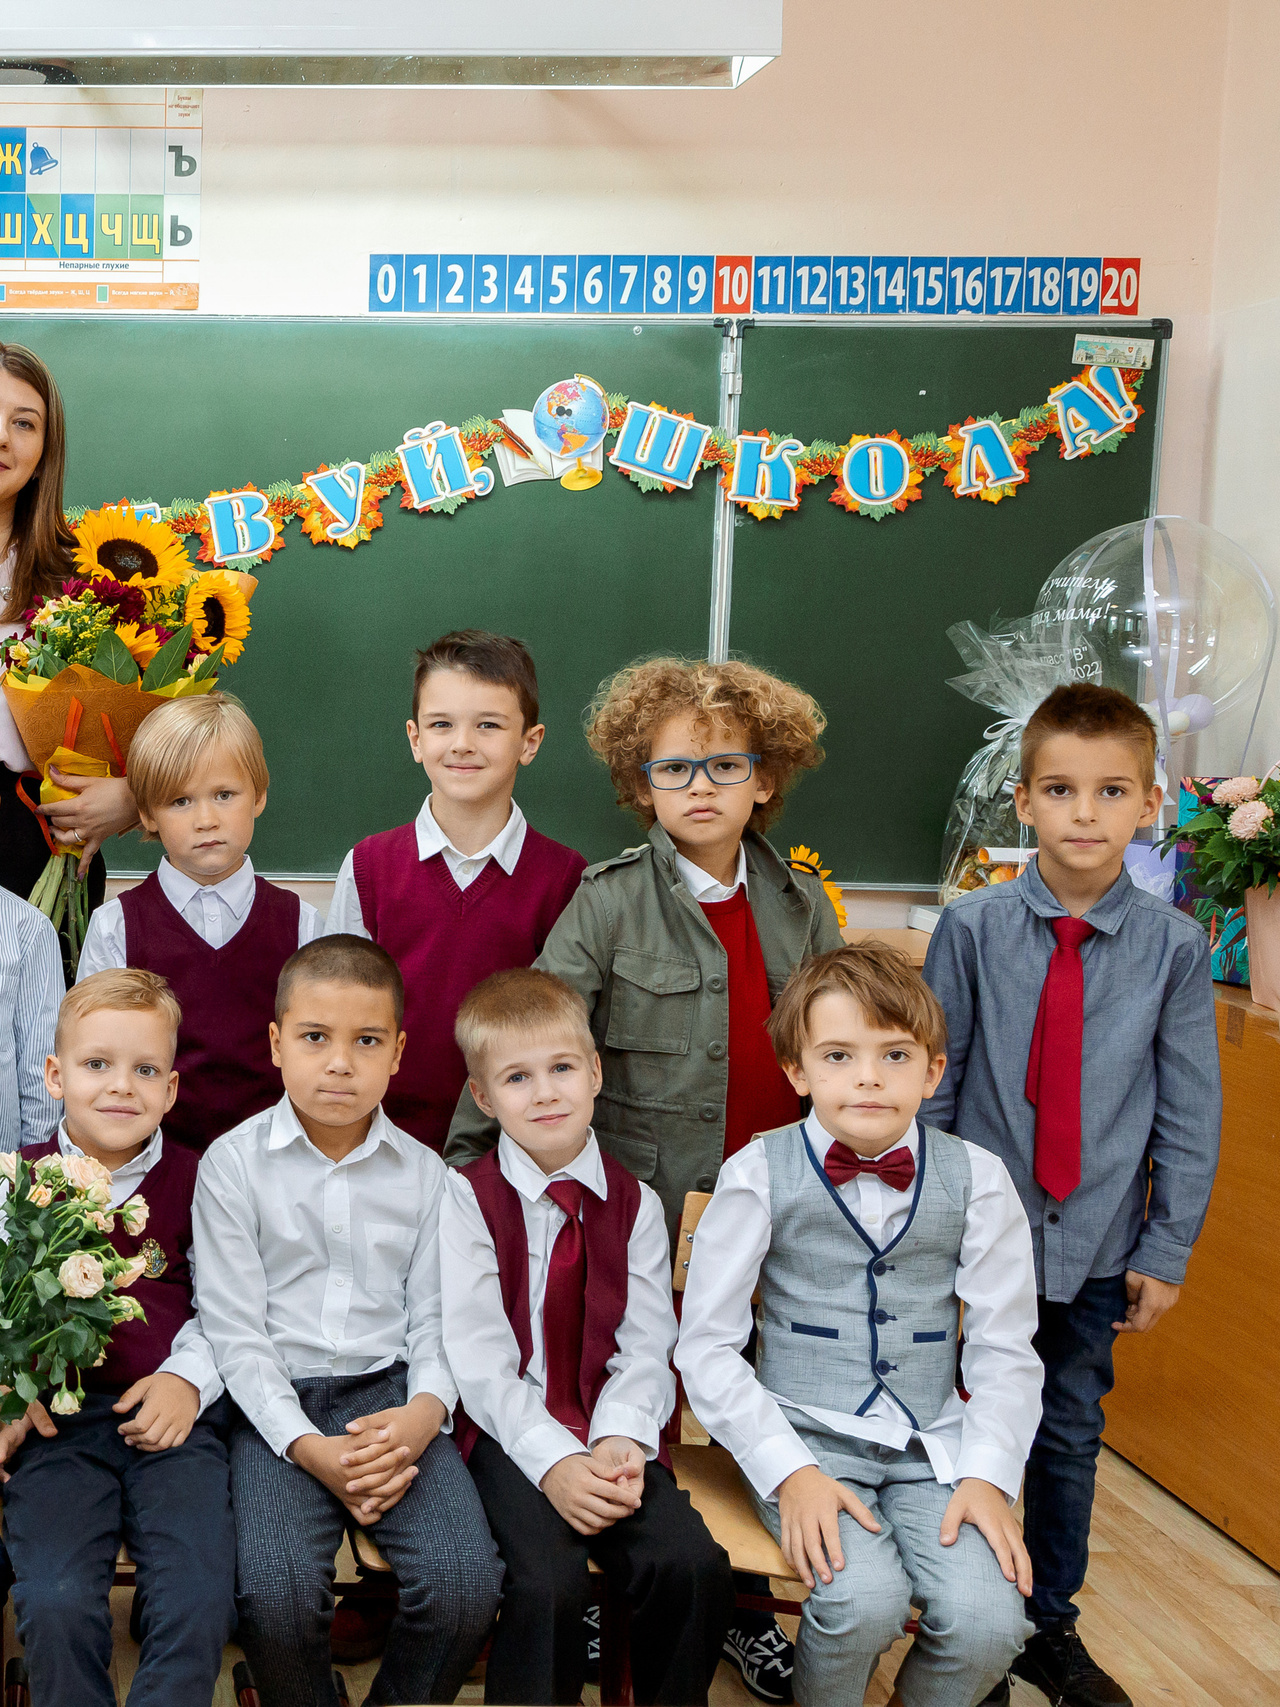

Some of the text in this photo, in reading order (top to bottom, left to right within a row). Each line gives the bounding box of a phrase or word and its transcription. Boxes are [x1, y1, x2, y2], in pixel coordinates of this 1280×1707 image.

[59, 261, 100, 270] Непарные
[377, 264, 1137, 307] 0 1 2 3 4 5 6 7 8 9 10 11 12 13 14 15 16 17 18 19 20
[608, 365, 1138, 507] ШКОЛА!
[1053, 602, 1111, 622] мама!
